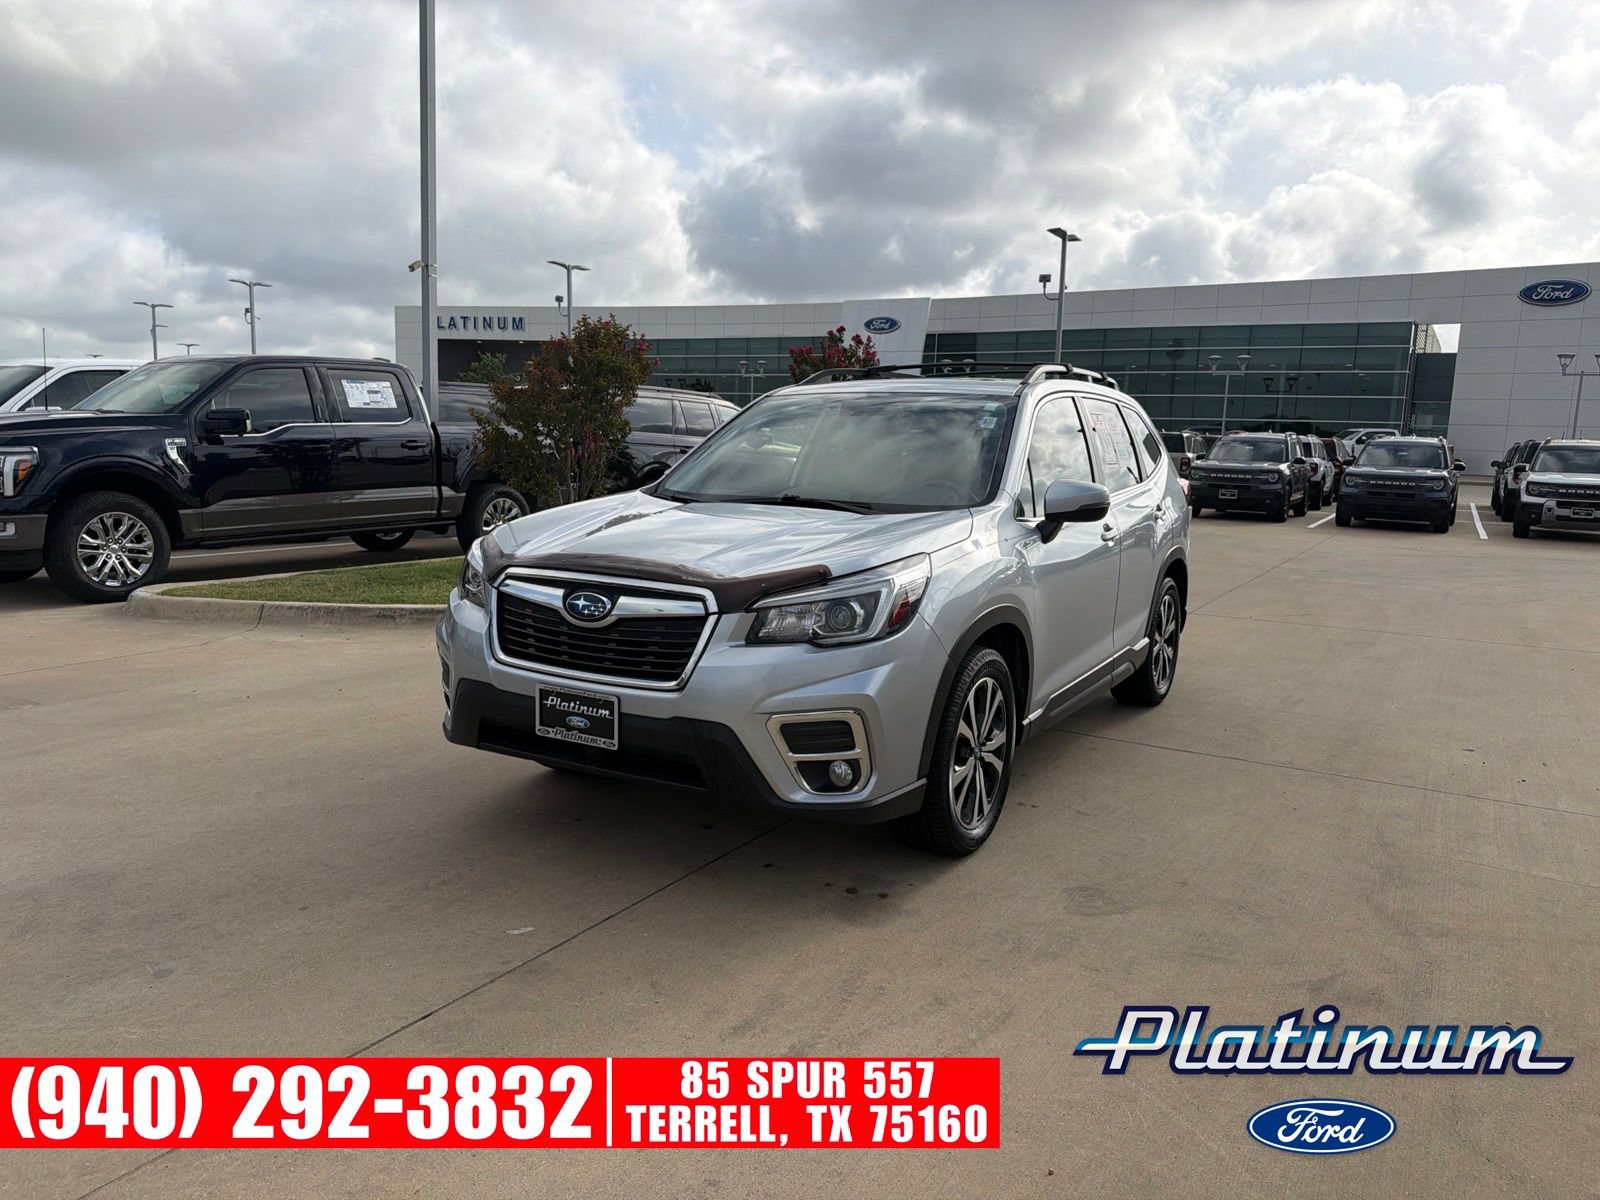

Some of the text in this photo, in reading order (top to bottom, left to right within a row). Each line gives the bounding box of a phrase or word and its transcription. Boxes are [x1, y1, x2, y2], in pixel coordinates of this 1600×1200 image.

[1532, 284, 1575, 300] Ford
[437, 316, 525, 331] LATINUM
[542, 696, 614, 719] Platinum
[553, 727, 602, 746] Platinum
